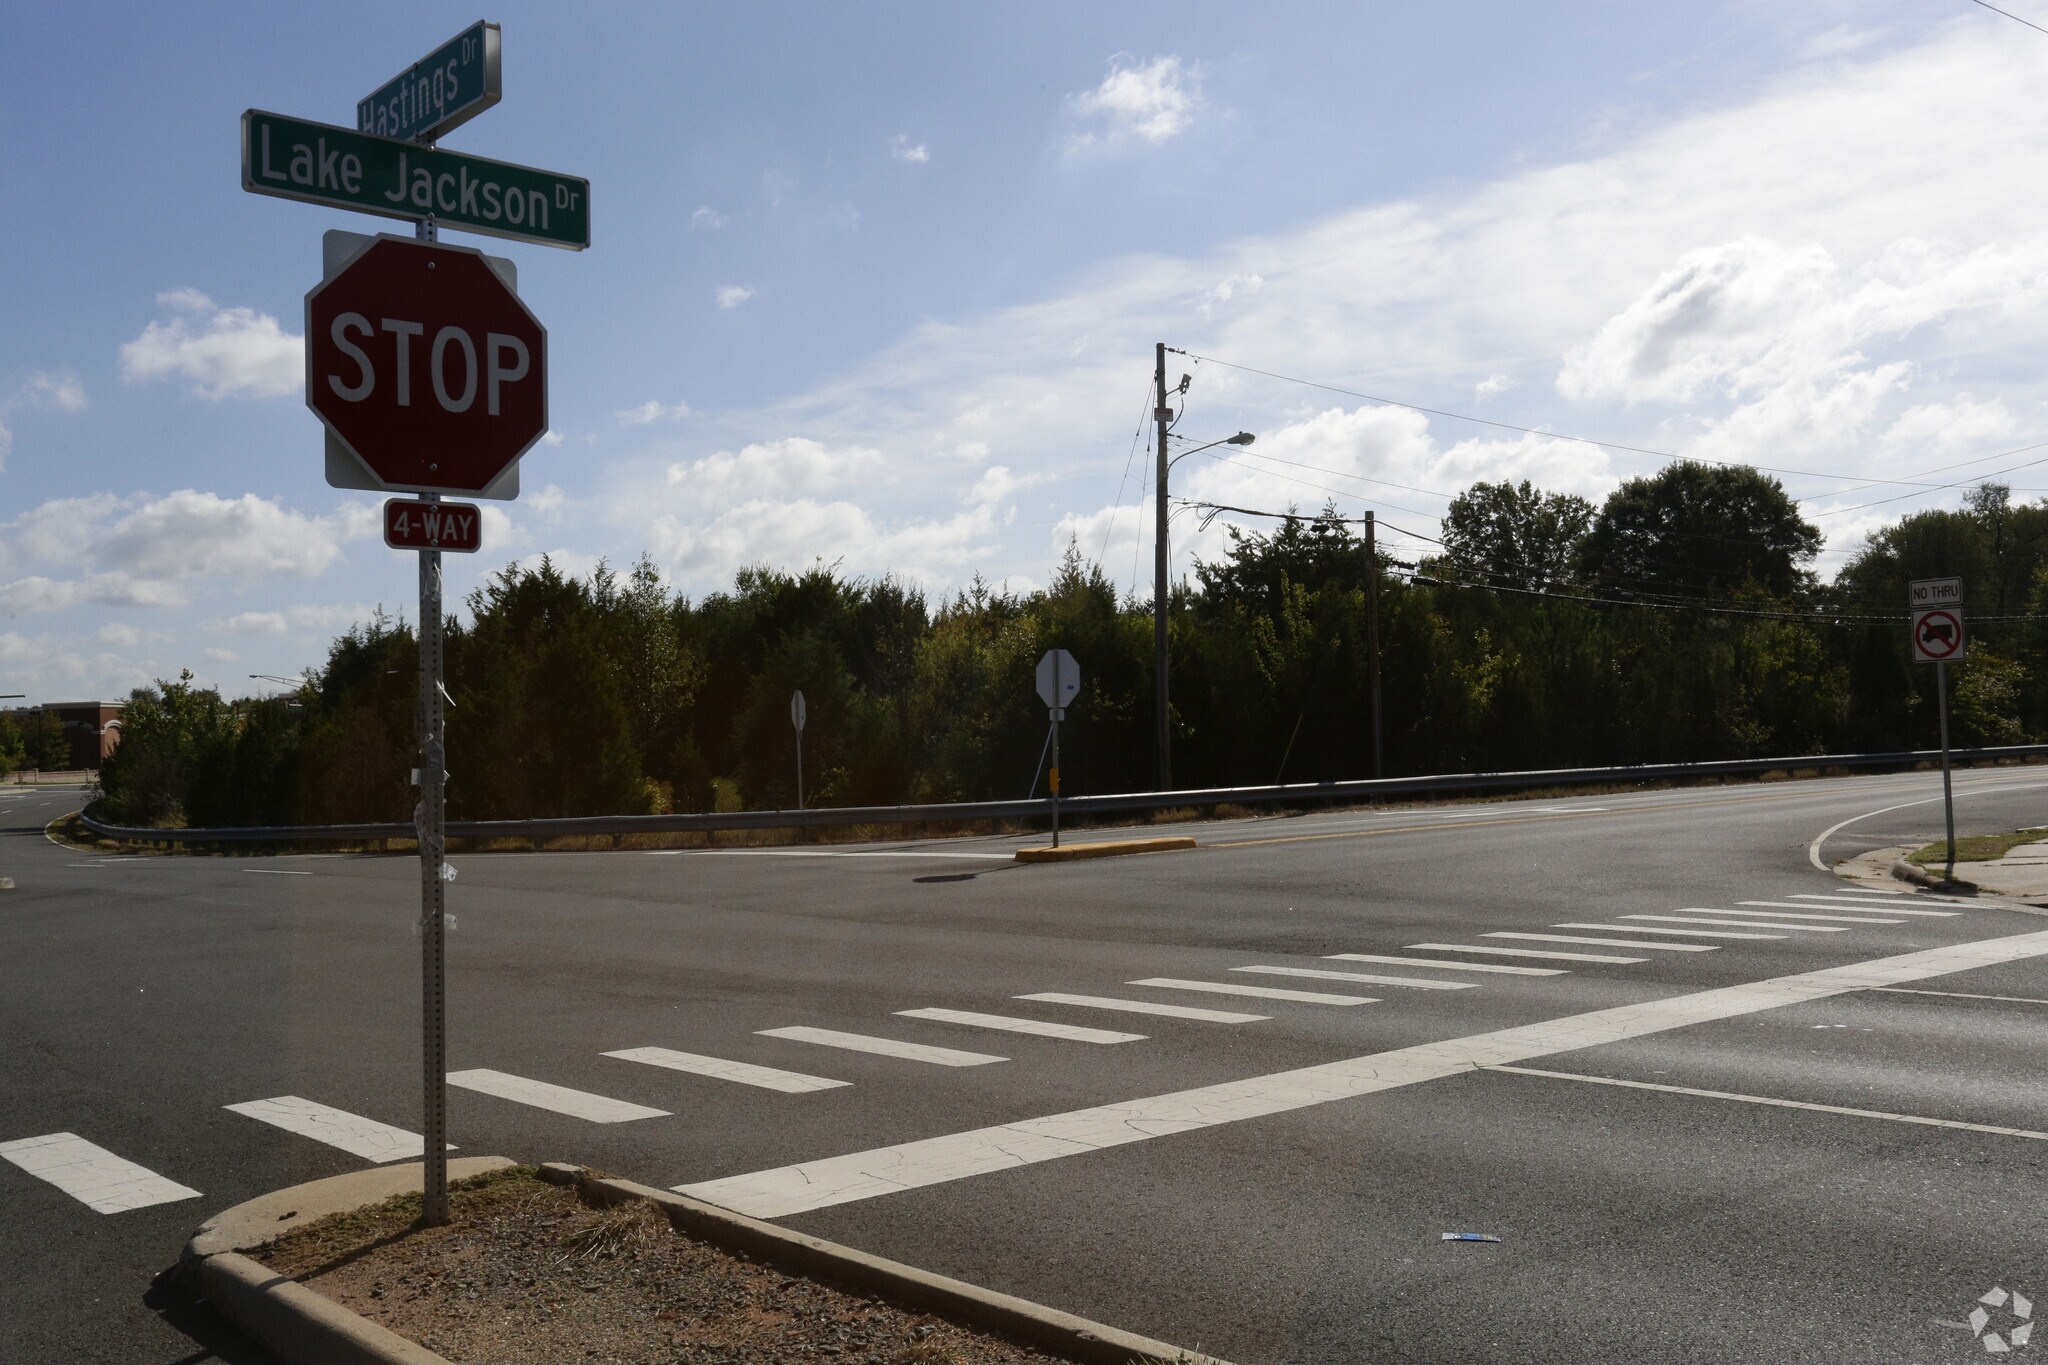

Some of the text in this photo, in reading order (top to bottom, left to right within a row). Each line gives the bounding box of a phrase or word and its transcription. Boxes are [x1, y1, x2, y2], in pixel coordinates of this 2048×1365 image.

[362, 37, 477, 135] Hastings Dr
[261, 123, 579, 230] Lake Jackson Dr
[327, 311, 530, 416] STOP
[393, 511, 473, 541] 4-WAY
[1913, 585, 1958, 600] NO THRU
